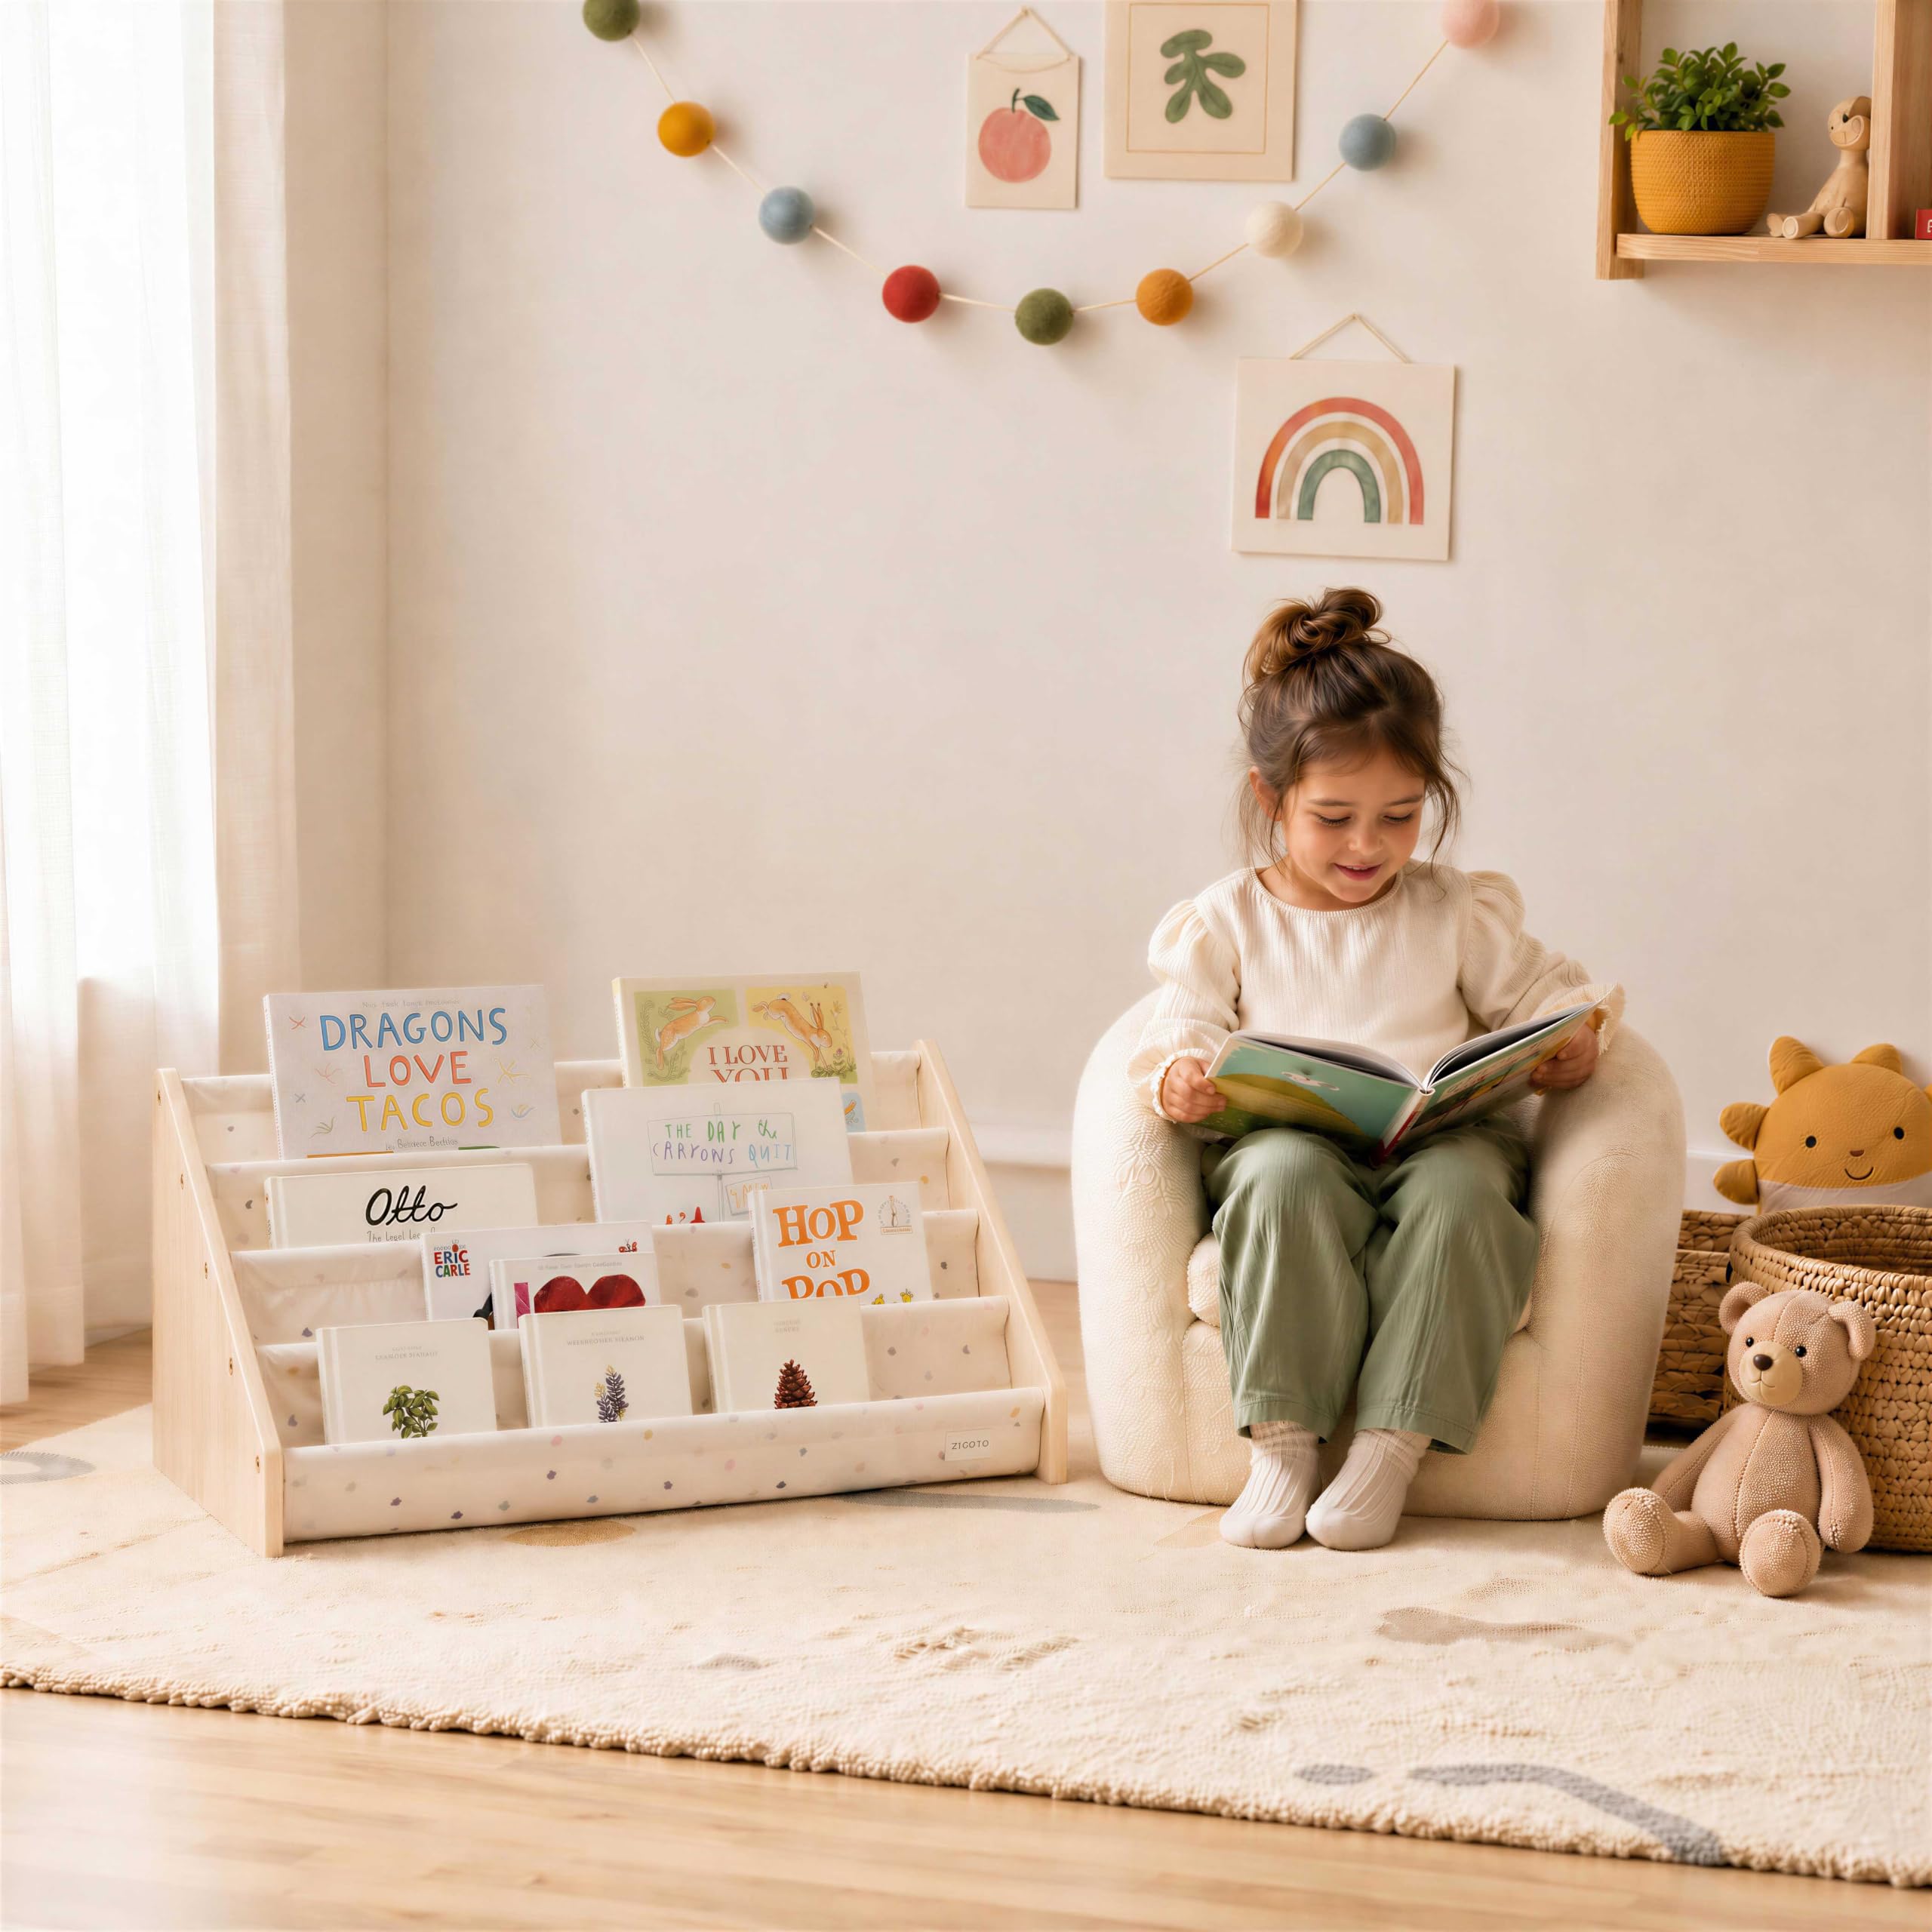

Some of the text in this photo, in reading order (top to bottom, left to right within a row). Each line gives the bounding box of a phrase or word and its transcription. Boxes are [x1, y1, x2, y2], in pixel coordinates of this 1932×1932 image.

[319, 1008, 508, 1051] DRAGONS
[707, 1044, 788, 1066] I LOVE
[363, 1051, 472, 1088] LOVE
[346, 1088, 494, 1132] TACOS
[665, 1124, 692, 1138] THE
[707, 1120, 741, 1143] DAY
[748, 1143, 791, 1168] QUIT
[365, 1185, 458, 1226] Otto
[772, 1199, 864, 1248] HOP
[434, 1244, 469, 1265] ERIC
[806, 1250, 837, 1269] ON
[435, 1263, 471, 1278] CARLE
